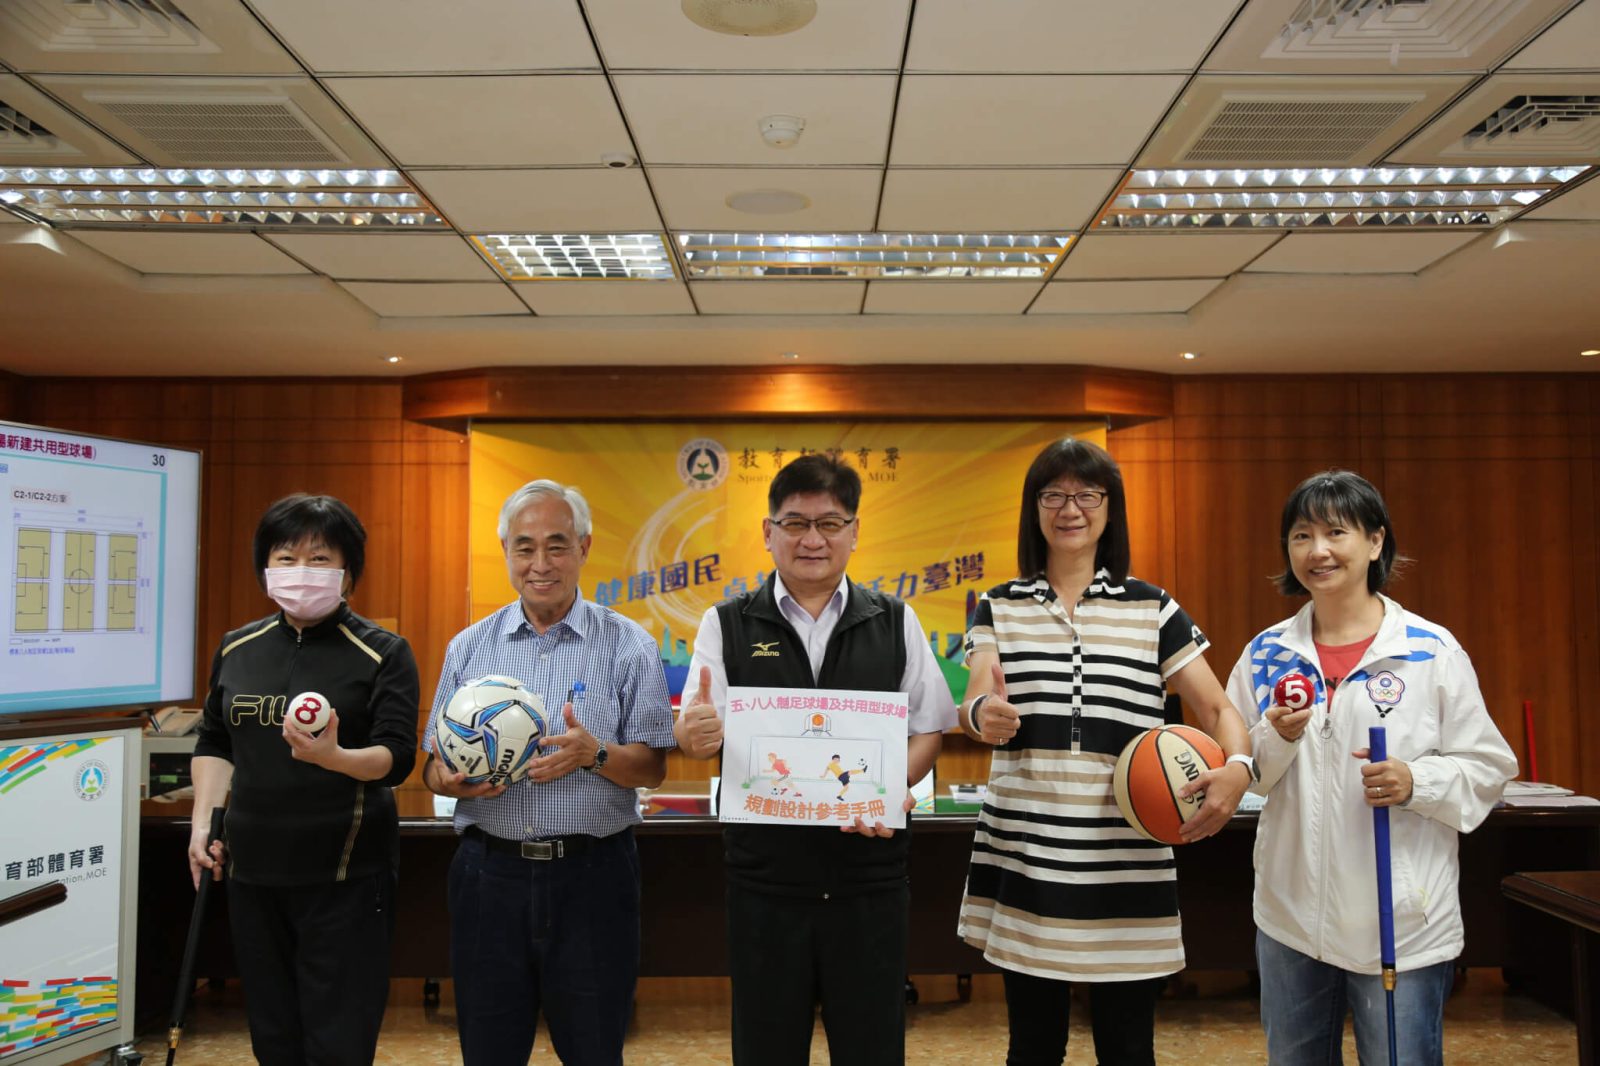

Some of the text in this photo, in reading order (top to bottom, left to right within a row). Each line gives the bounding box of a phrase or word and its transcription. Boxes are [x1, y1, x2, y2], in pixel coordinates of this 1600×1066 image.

[152, 454, 166, 467] 30
[737, 447, 901, 469] 教育育署
[595, 553, 721, 607] 健康國民
[1285, 680, 1308, 709] 5
[230, 694, 287, 726] FIL
[295, 697, 322, 725] 8
[744, 793, 886, 821] 規劃設計參考手冊
